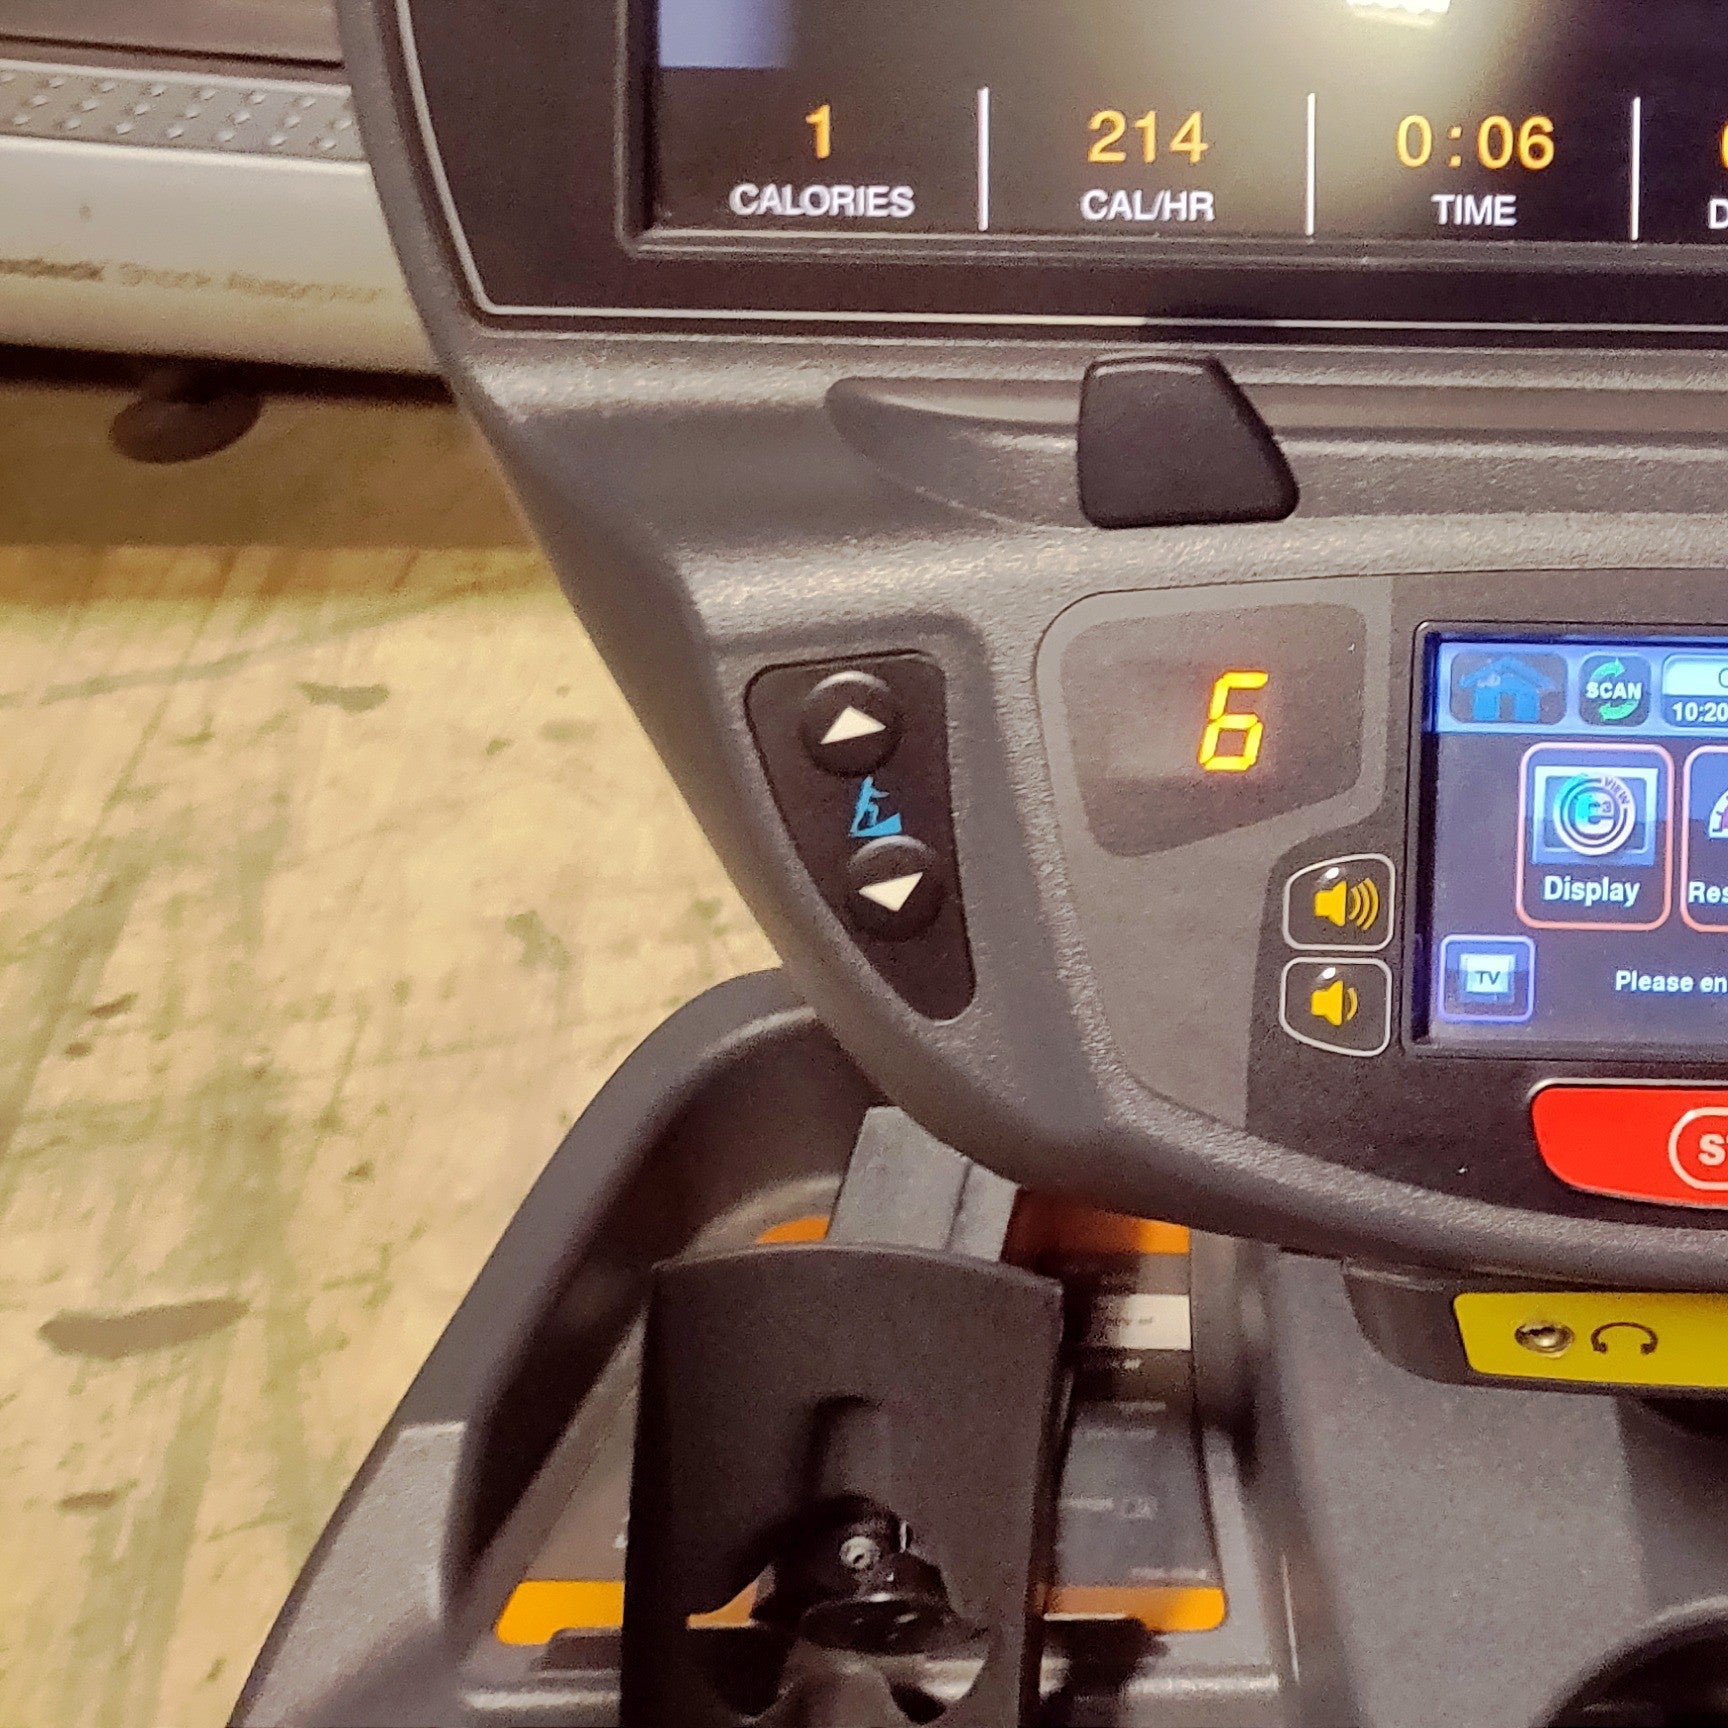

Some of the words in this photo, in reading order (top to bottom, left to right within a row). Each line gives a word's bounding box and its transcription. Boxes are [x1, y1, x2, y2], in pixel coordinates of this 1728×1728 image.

[804, 103, 831, 159] 1
[1087, 110, 1209, 164] 214
[1396, 114, 1556, 171] 0:06
[728, 183, 915, 219] CALORIES
[1079, 188, 1216, 222] CAL/HR
[1430, 193, 1518, 227] TIME
[1585, 680, 1643, 701] SCAN
[1198, 670, 1269, 772] 6
[1543, 874, 1641, 908] Display
[1474, 970, 1501, 986] TV
[1615, 969, 1694, 993] Please
